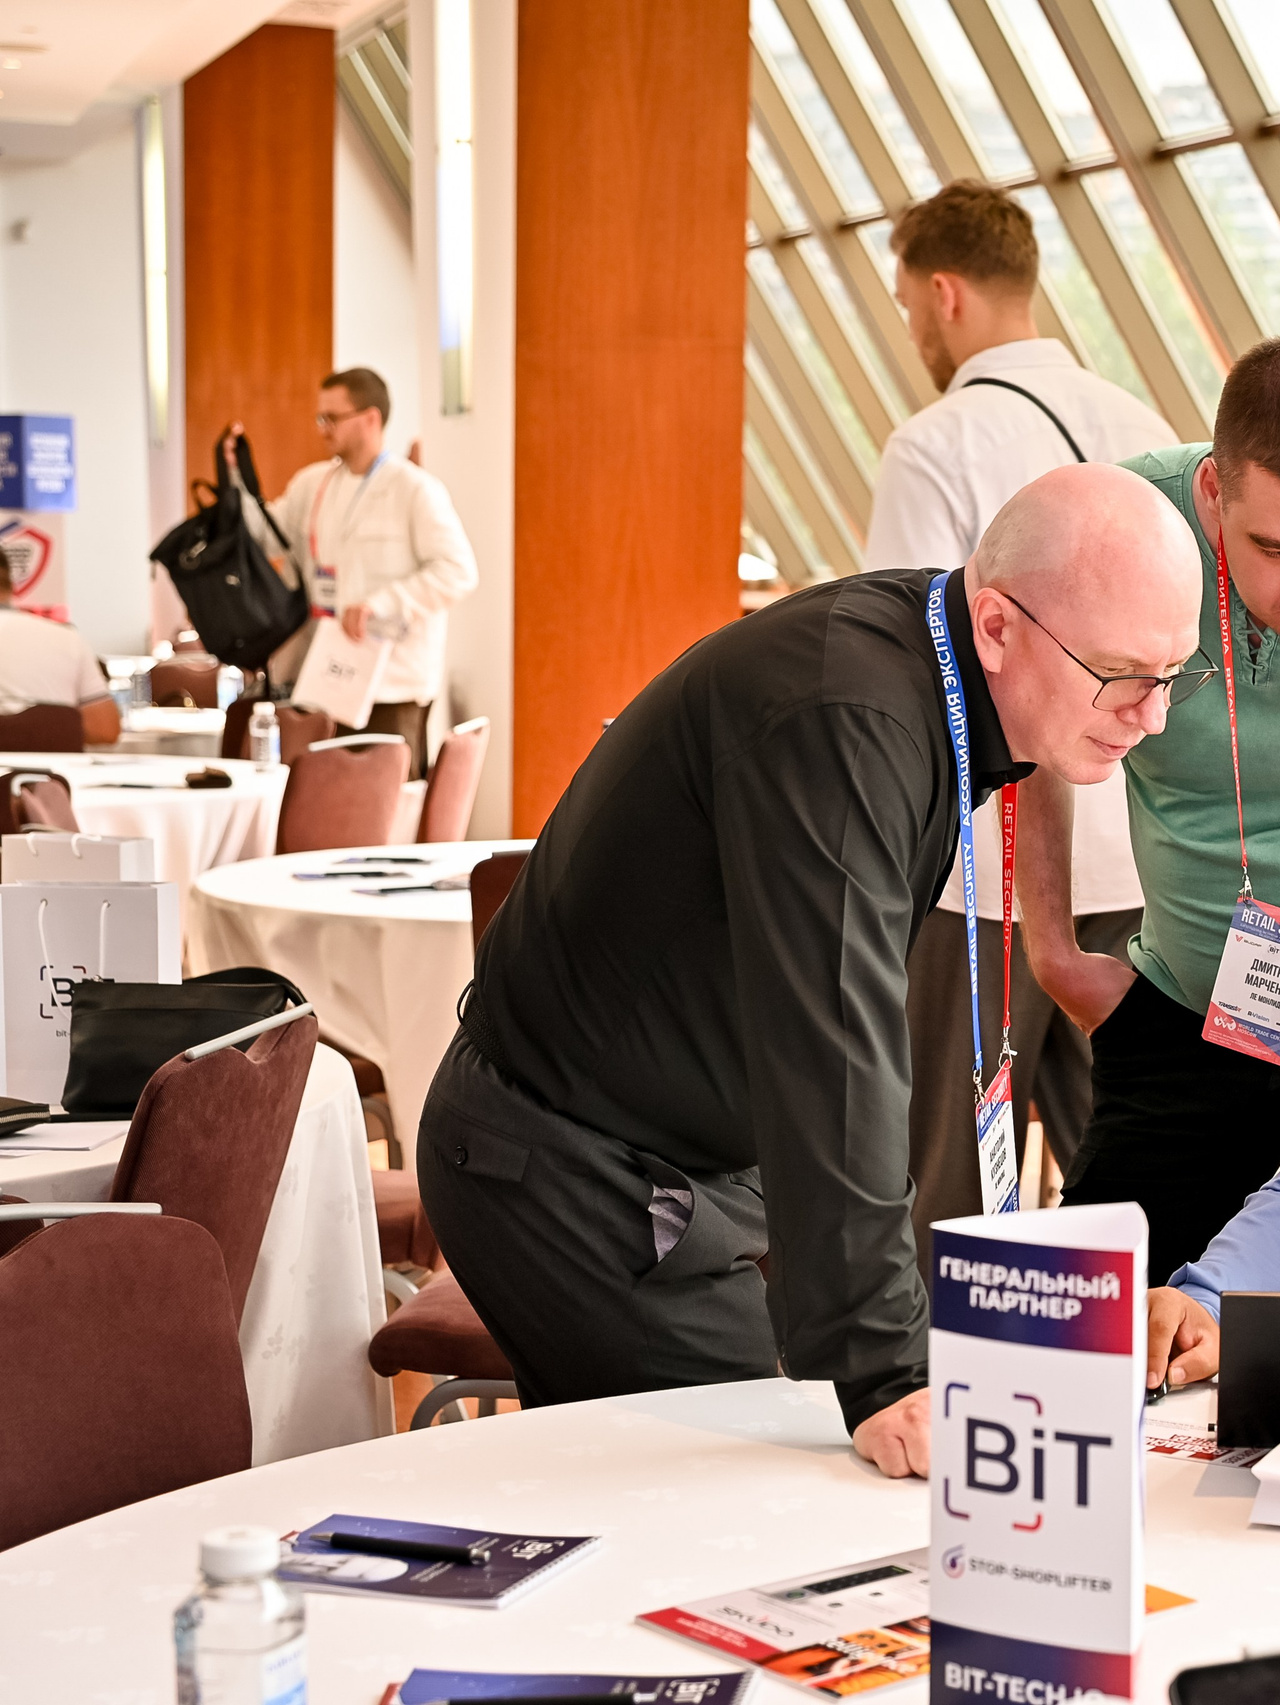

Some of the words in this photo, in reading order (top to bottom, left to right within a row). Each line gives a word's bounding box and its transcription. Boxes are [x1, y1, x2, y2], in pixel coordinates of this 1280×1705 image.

[928, 587, 958, 688] ЭКСПЕРТОВ
[1217, 576, 1230, 655] РИТЕЙЛА
[1225, 667, 1235, 721] RETAIL
[946, 692, 971, 827] АССОЦИАЦИЯ
[1004, 802, 1014, 864] RETAIL
[963, 842, 977, 930] SECURITY
[1003, 872, 1013, 952] SECURITY
[1241, 908, 1276, 932] RETAIL
[968, 932, 978, 995] RETAIL
[1249, 992, 1258, 1001] ЛЕ
[940, 1255, 1121, 1301] ГЕНЕРАЛЬНЫЙ
[969, 1284, 1083, 1320] ПАРТНЕР
[966, 1416, 1113, 1508] BiT
[969, 1557, 1113, 1593] STOP-SHOPLIFTER
